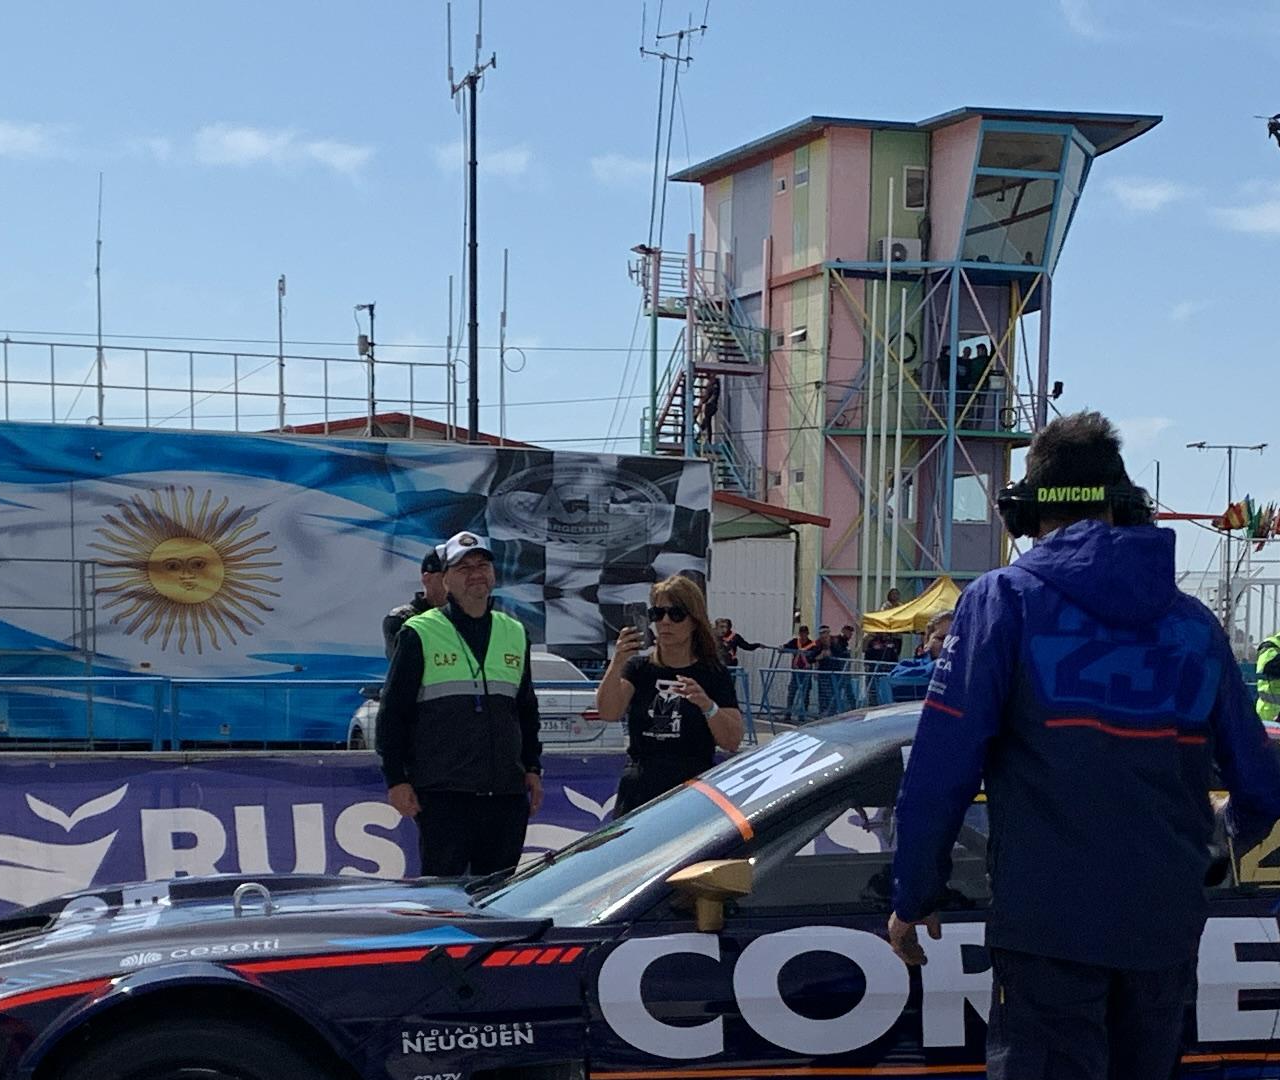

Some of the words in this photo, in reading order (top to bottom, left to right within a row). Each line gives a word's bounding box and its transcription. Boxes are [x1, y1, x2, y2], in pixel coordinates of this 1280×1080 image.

[1037, 486, 1105, 502] DAVICOM
[140, 801, 406, 880] RUS
[401, 1022, 533, 1039] RADIADORES
[401, 1028, 535, 1054] NEUQUEN
